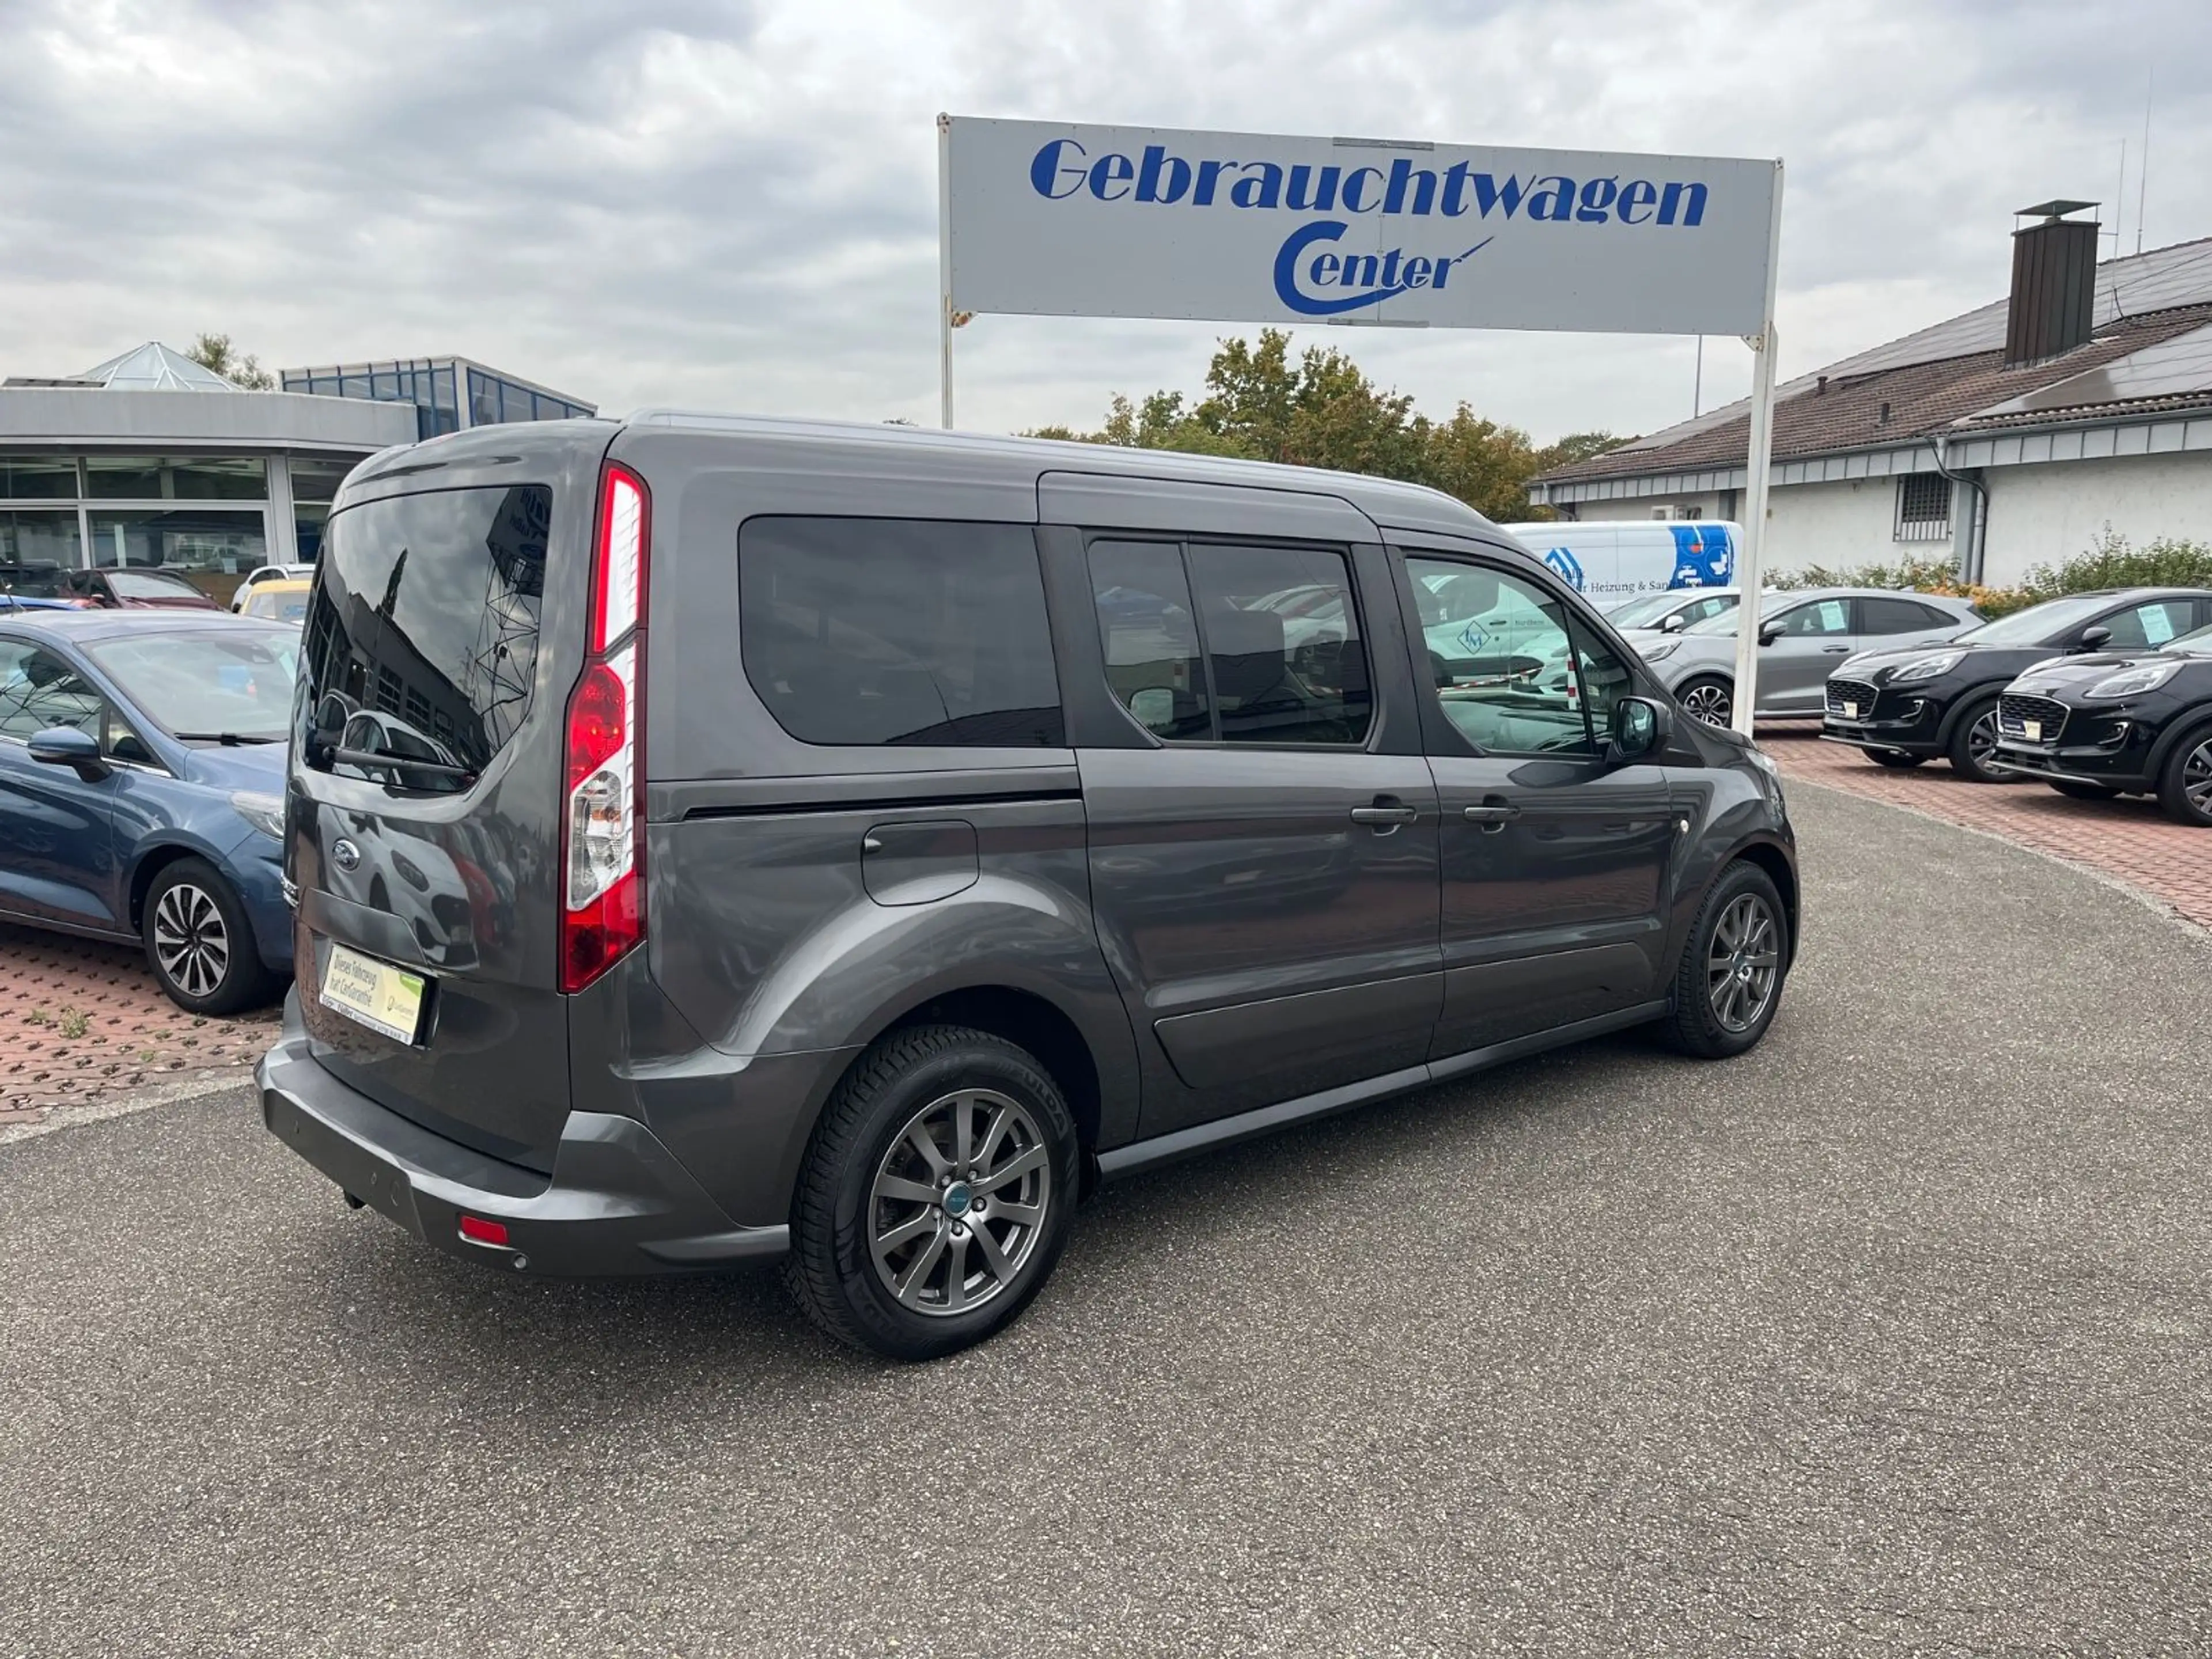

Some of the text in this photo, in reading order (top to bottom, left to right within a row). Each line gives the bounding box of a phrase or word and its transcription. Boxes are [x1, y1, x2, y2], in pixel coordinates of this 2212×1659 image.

[1030, 139, 1708, 227] Gebrauchtwagen
[1274, 220, 1492, 316] Center
[1590, 582, 1635, 594] Heizung
[1638, 581, 1646, 592] &
